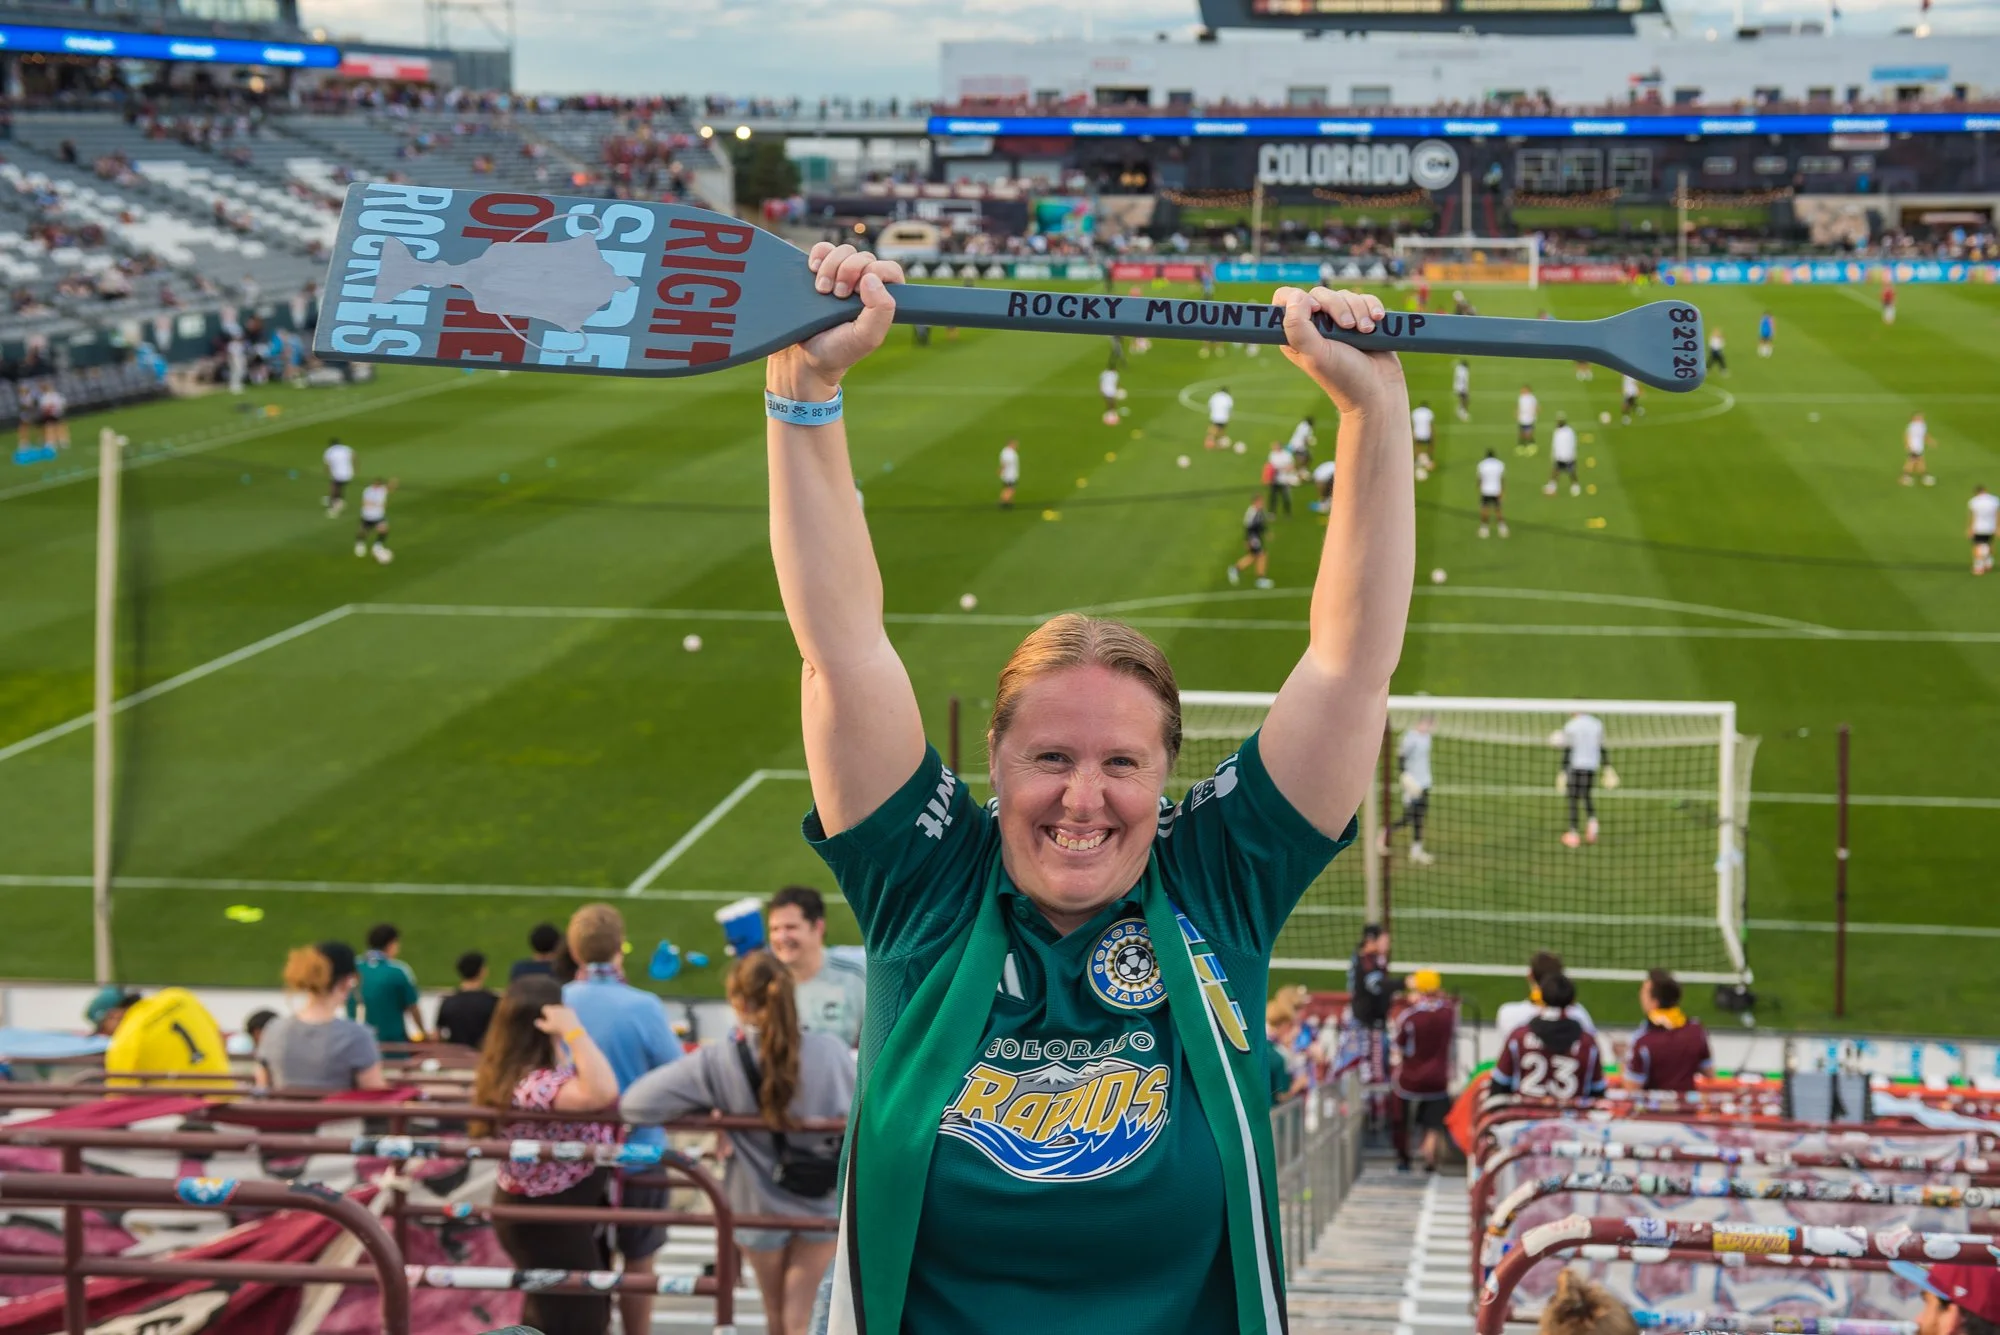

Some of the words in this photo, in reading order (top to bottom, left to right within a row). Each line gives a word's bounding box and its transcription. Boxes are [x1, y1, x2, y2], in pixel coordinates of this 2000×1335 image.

[1258, 143, 1410, 185] COLORADO
[643, 218, 755, 366] RIGHT
[1008, 290, 1123, 320] ROCKY
[1145, 300, 1334, 333] MOUNTAN
[1364, 314, 1426, 337] UP
[436, 285, 529, 364] HE
[767, 400, 788, 413] CENTE
[915, 763, 956, 840] wit
[1093, 924, 1149, 974] COLORA
[1105, 983, 1164, 1003] RAPID
[1520, 1051, 1581, 1099] 23
[955, 1062, 1171, 1142] RAPIDS
